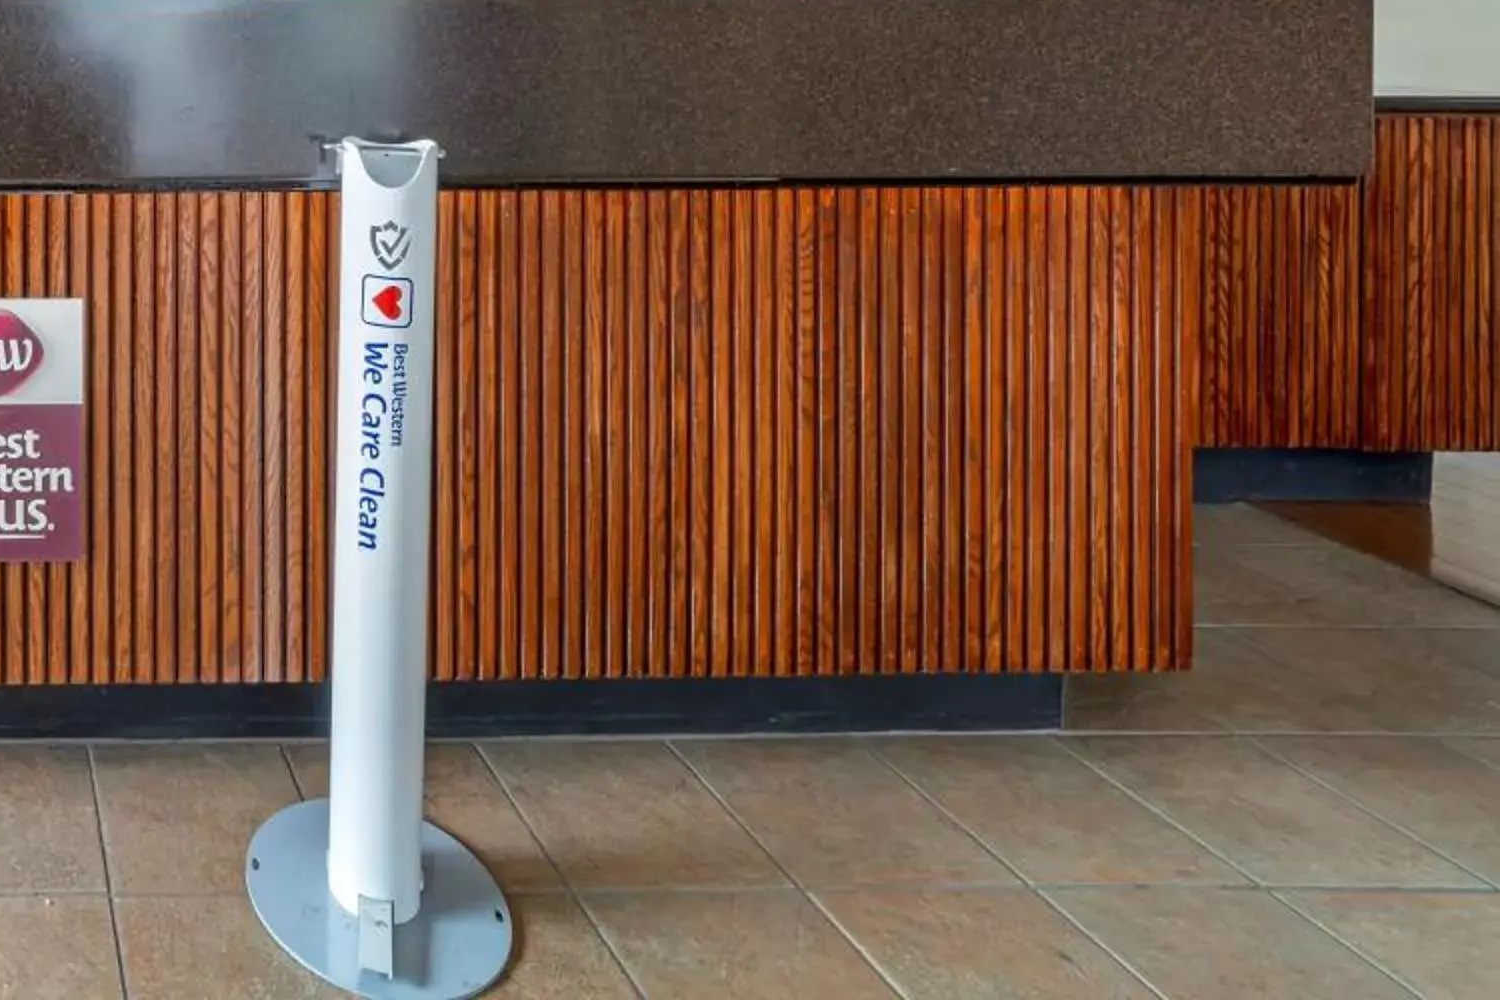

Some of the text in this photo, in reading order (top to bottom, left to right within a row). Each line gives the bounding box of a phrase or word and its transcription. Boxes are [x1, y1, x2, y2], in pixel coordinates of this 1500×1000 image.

[357, 342, 389, 551] We Care Clean
[390, 343, 409, 447] Best Western
